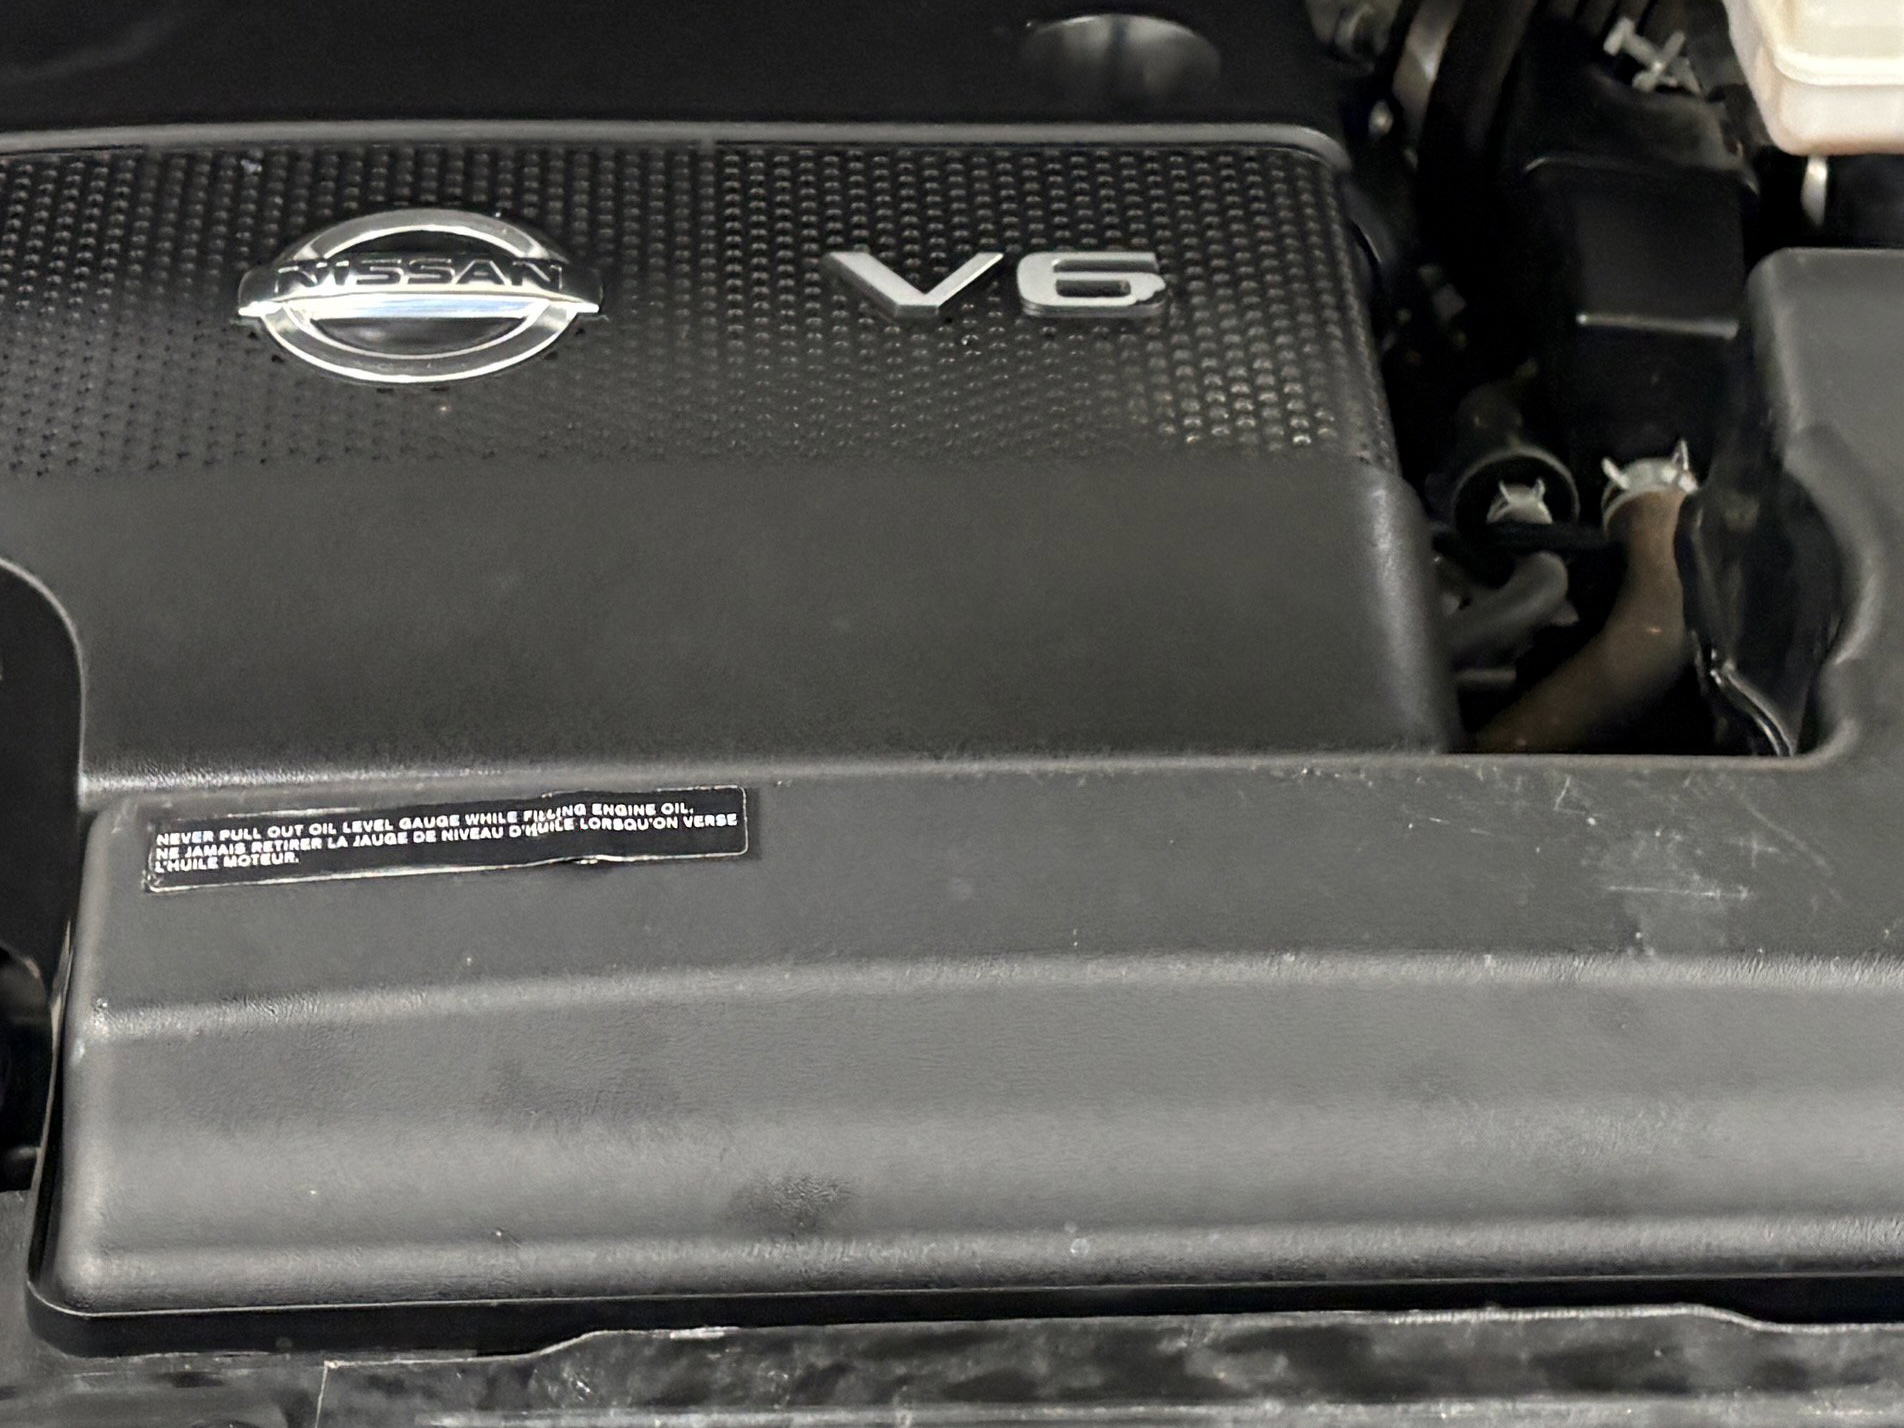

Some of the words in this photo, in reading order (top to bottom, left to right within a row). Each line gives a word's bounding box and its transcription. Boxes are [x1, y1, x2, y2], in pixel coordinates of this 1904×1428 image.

[276, 253, 566, 292] NISSAN
[820, 250, 1168, 319] V6
[155, 846, 179, 861] NE
[185, 842, 246, 858] JAMAIS
[251, 837, 323, 855] RETIRER
[328, 836, 348, 849] LA
[353, 831, 408, 847] JAUGE
[413, 829, 436, 843] DE
[441, 826, 504, 842] NIVEAU
[509, 816, 574, 837] D'HUILE
[580, 816, 679, 831] LORSQU'ON
[683, 813, 738, 828] VERSE
[156, 830, 214, 846] NEVER
[219, 827, 262, 842] PULL
[267, 824, 304, 838] OUT
[309, 822, 337, 836] OIL
[343, 818, 396, 833] LEVEL
[399, 814, 460, 830] GAUGE
[465, 810, 518, 825] WHILE
[523, 803, 586, 822] FILLING
[592, 803, 656, 817] ENGINE
[155, 856, 219, 873] L'HUILE
[224, 852, 299, 868] MOTEUR.
